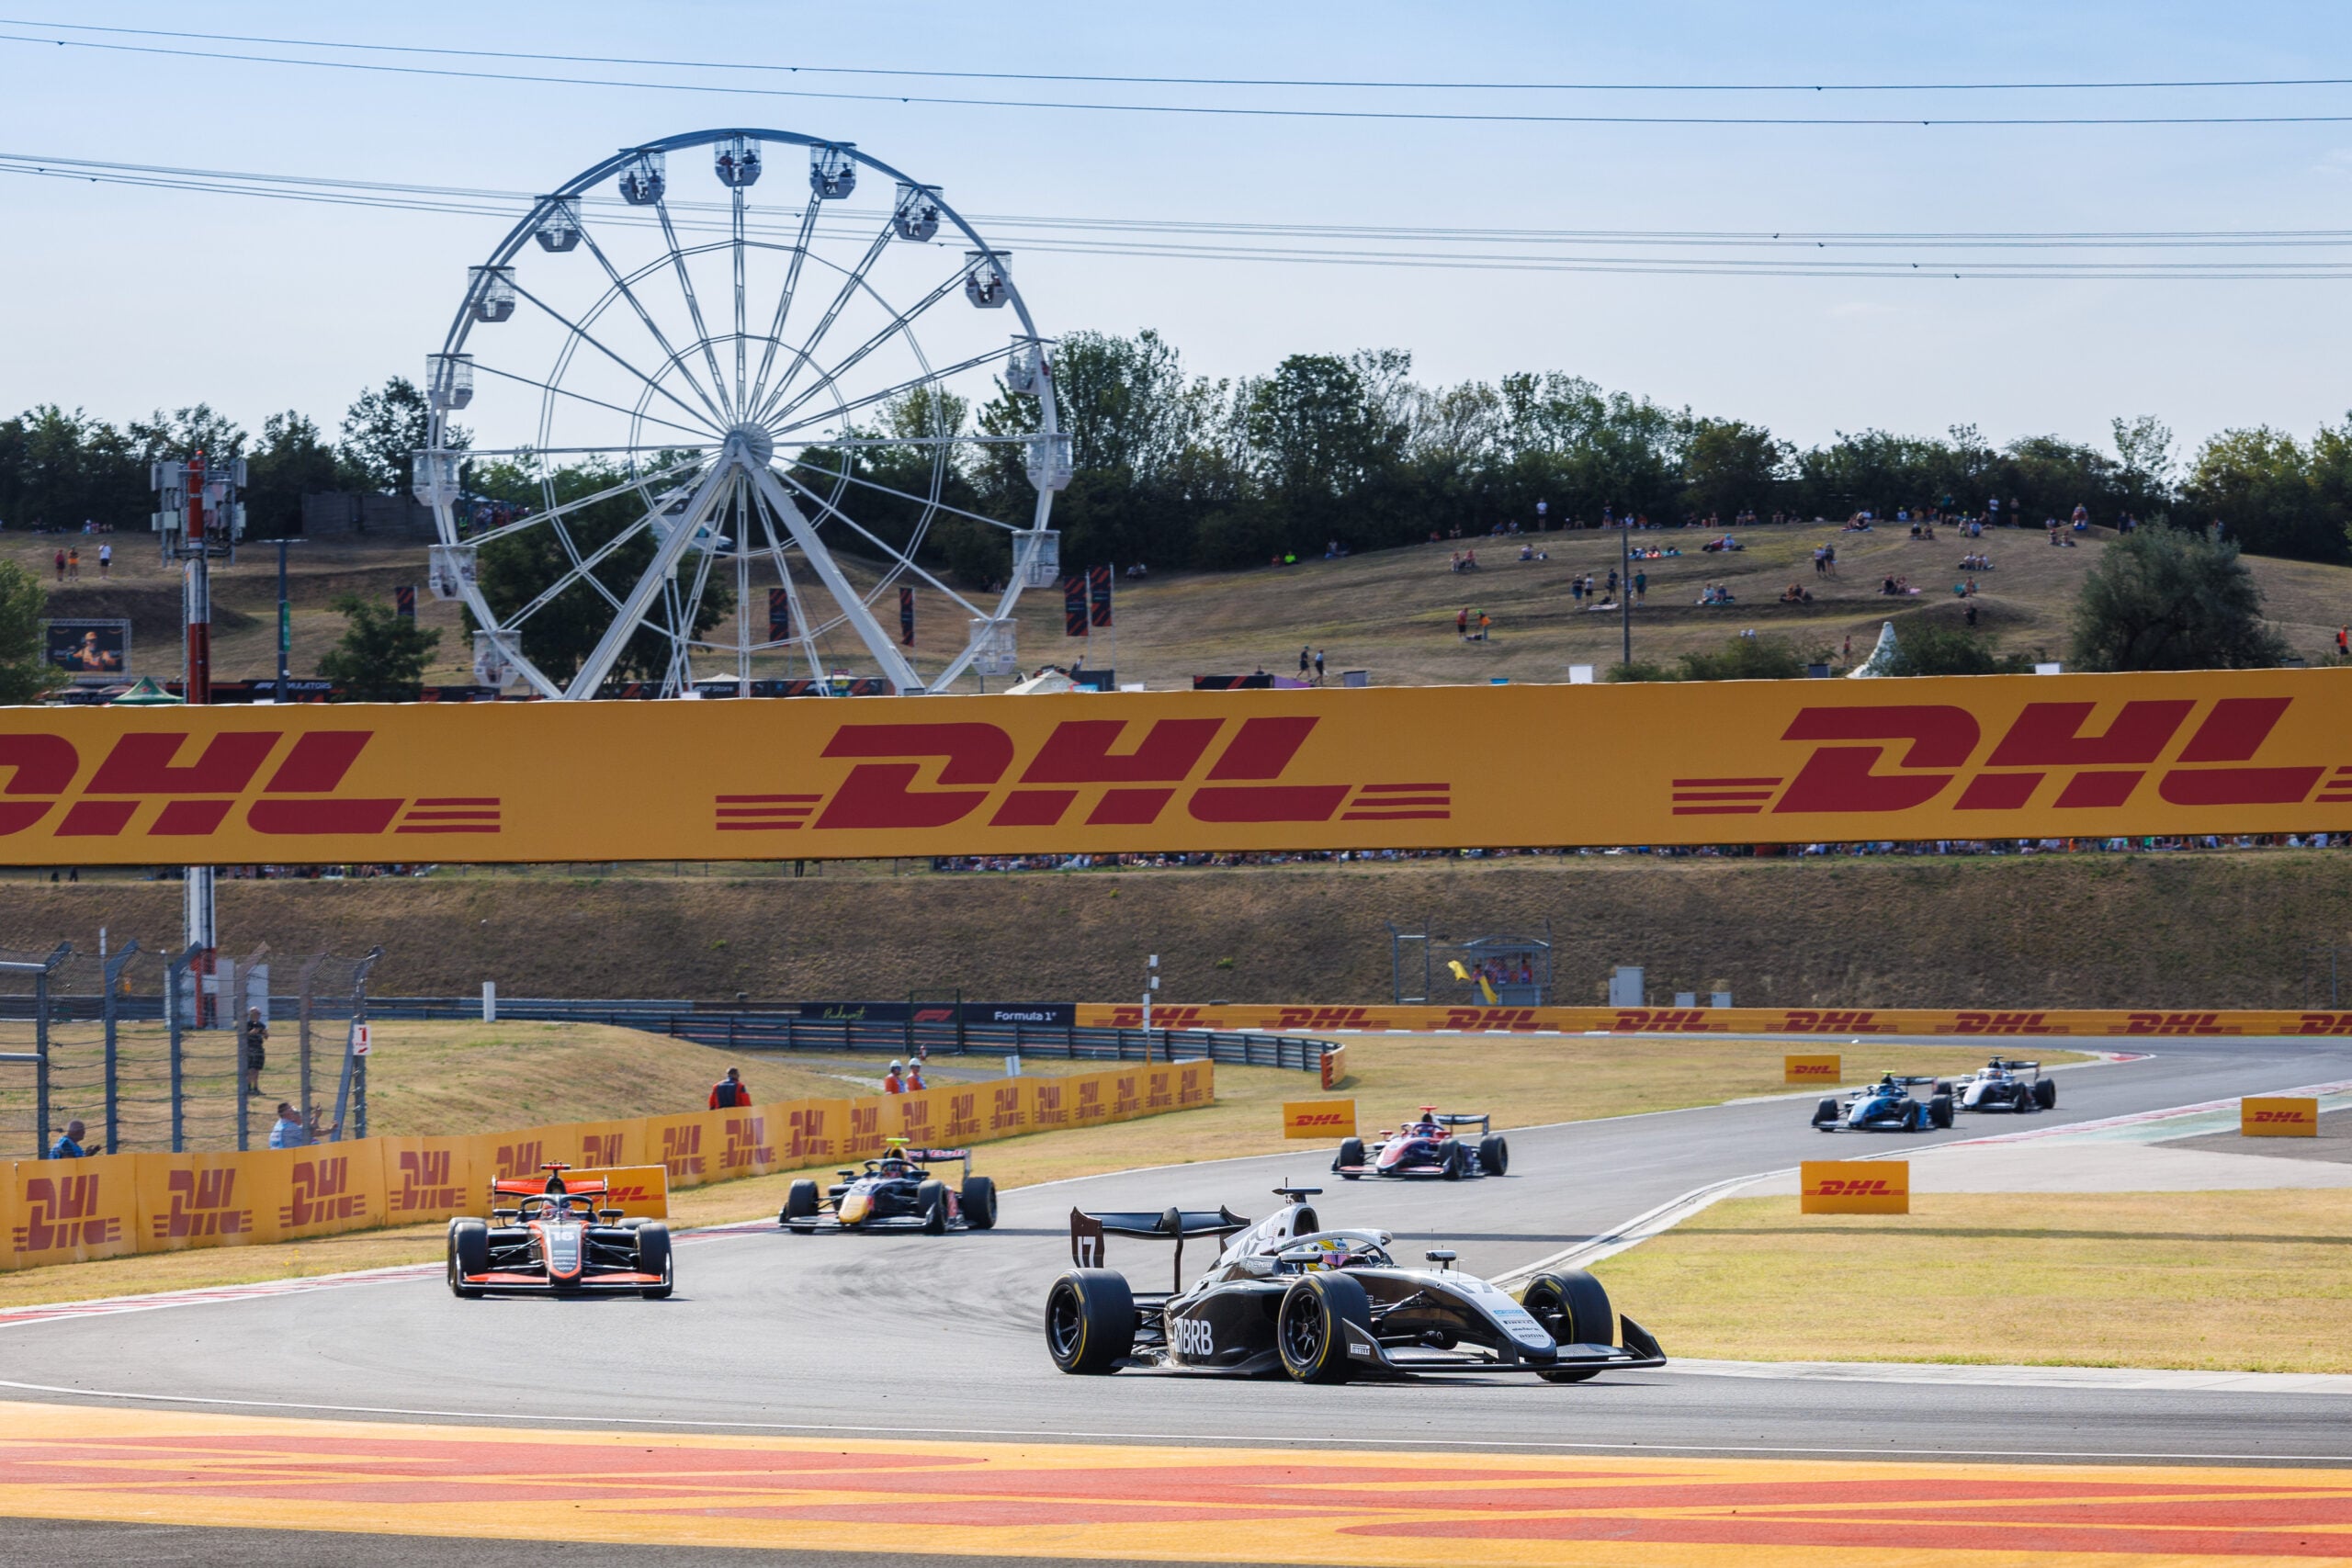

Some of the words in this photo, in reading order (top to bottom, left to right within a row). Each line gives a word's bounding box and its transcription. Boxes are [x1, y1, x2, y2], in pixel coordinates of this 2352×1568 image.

[1771, 697, 2326, 813] DHL
[813, 716, 1352, 829] DHL
[994, 1010, 1042, 1022] Formula
[1112, 1008, 1205, 1027] DHL
[1279, 1009, 1373, 1027] DHL
[1446, 1010, 1541, 1029] DHL
[1615, 1011, 1710, 1031] DHL
[1784, 1012, 1880, 1032] DHL
[1955, 1013, 2051, 1032] DHL
[2127, 1014, 2223, 1033] DHL
[1793, 1066, 1833, 1074] DHL
[1295, 1114, 1344, 1126] DHL
[2254, 1111, 2307, 1123] DHL
[1818, 1179, 1891, 1195] DHL
[27, 1174, 107, 1251] DHL
[550, 1232, 575, 1242] 16
[1077, 1236, 1096, 1268] 17
[1182, 1319, 1214, 1356] BRB
